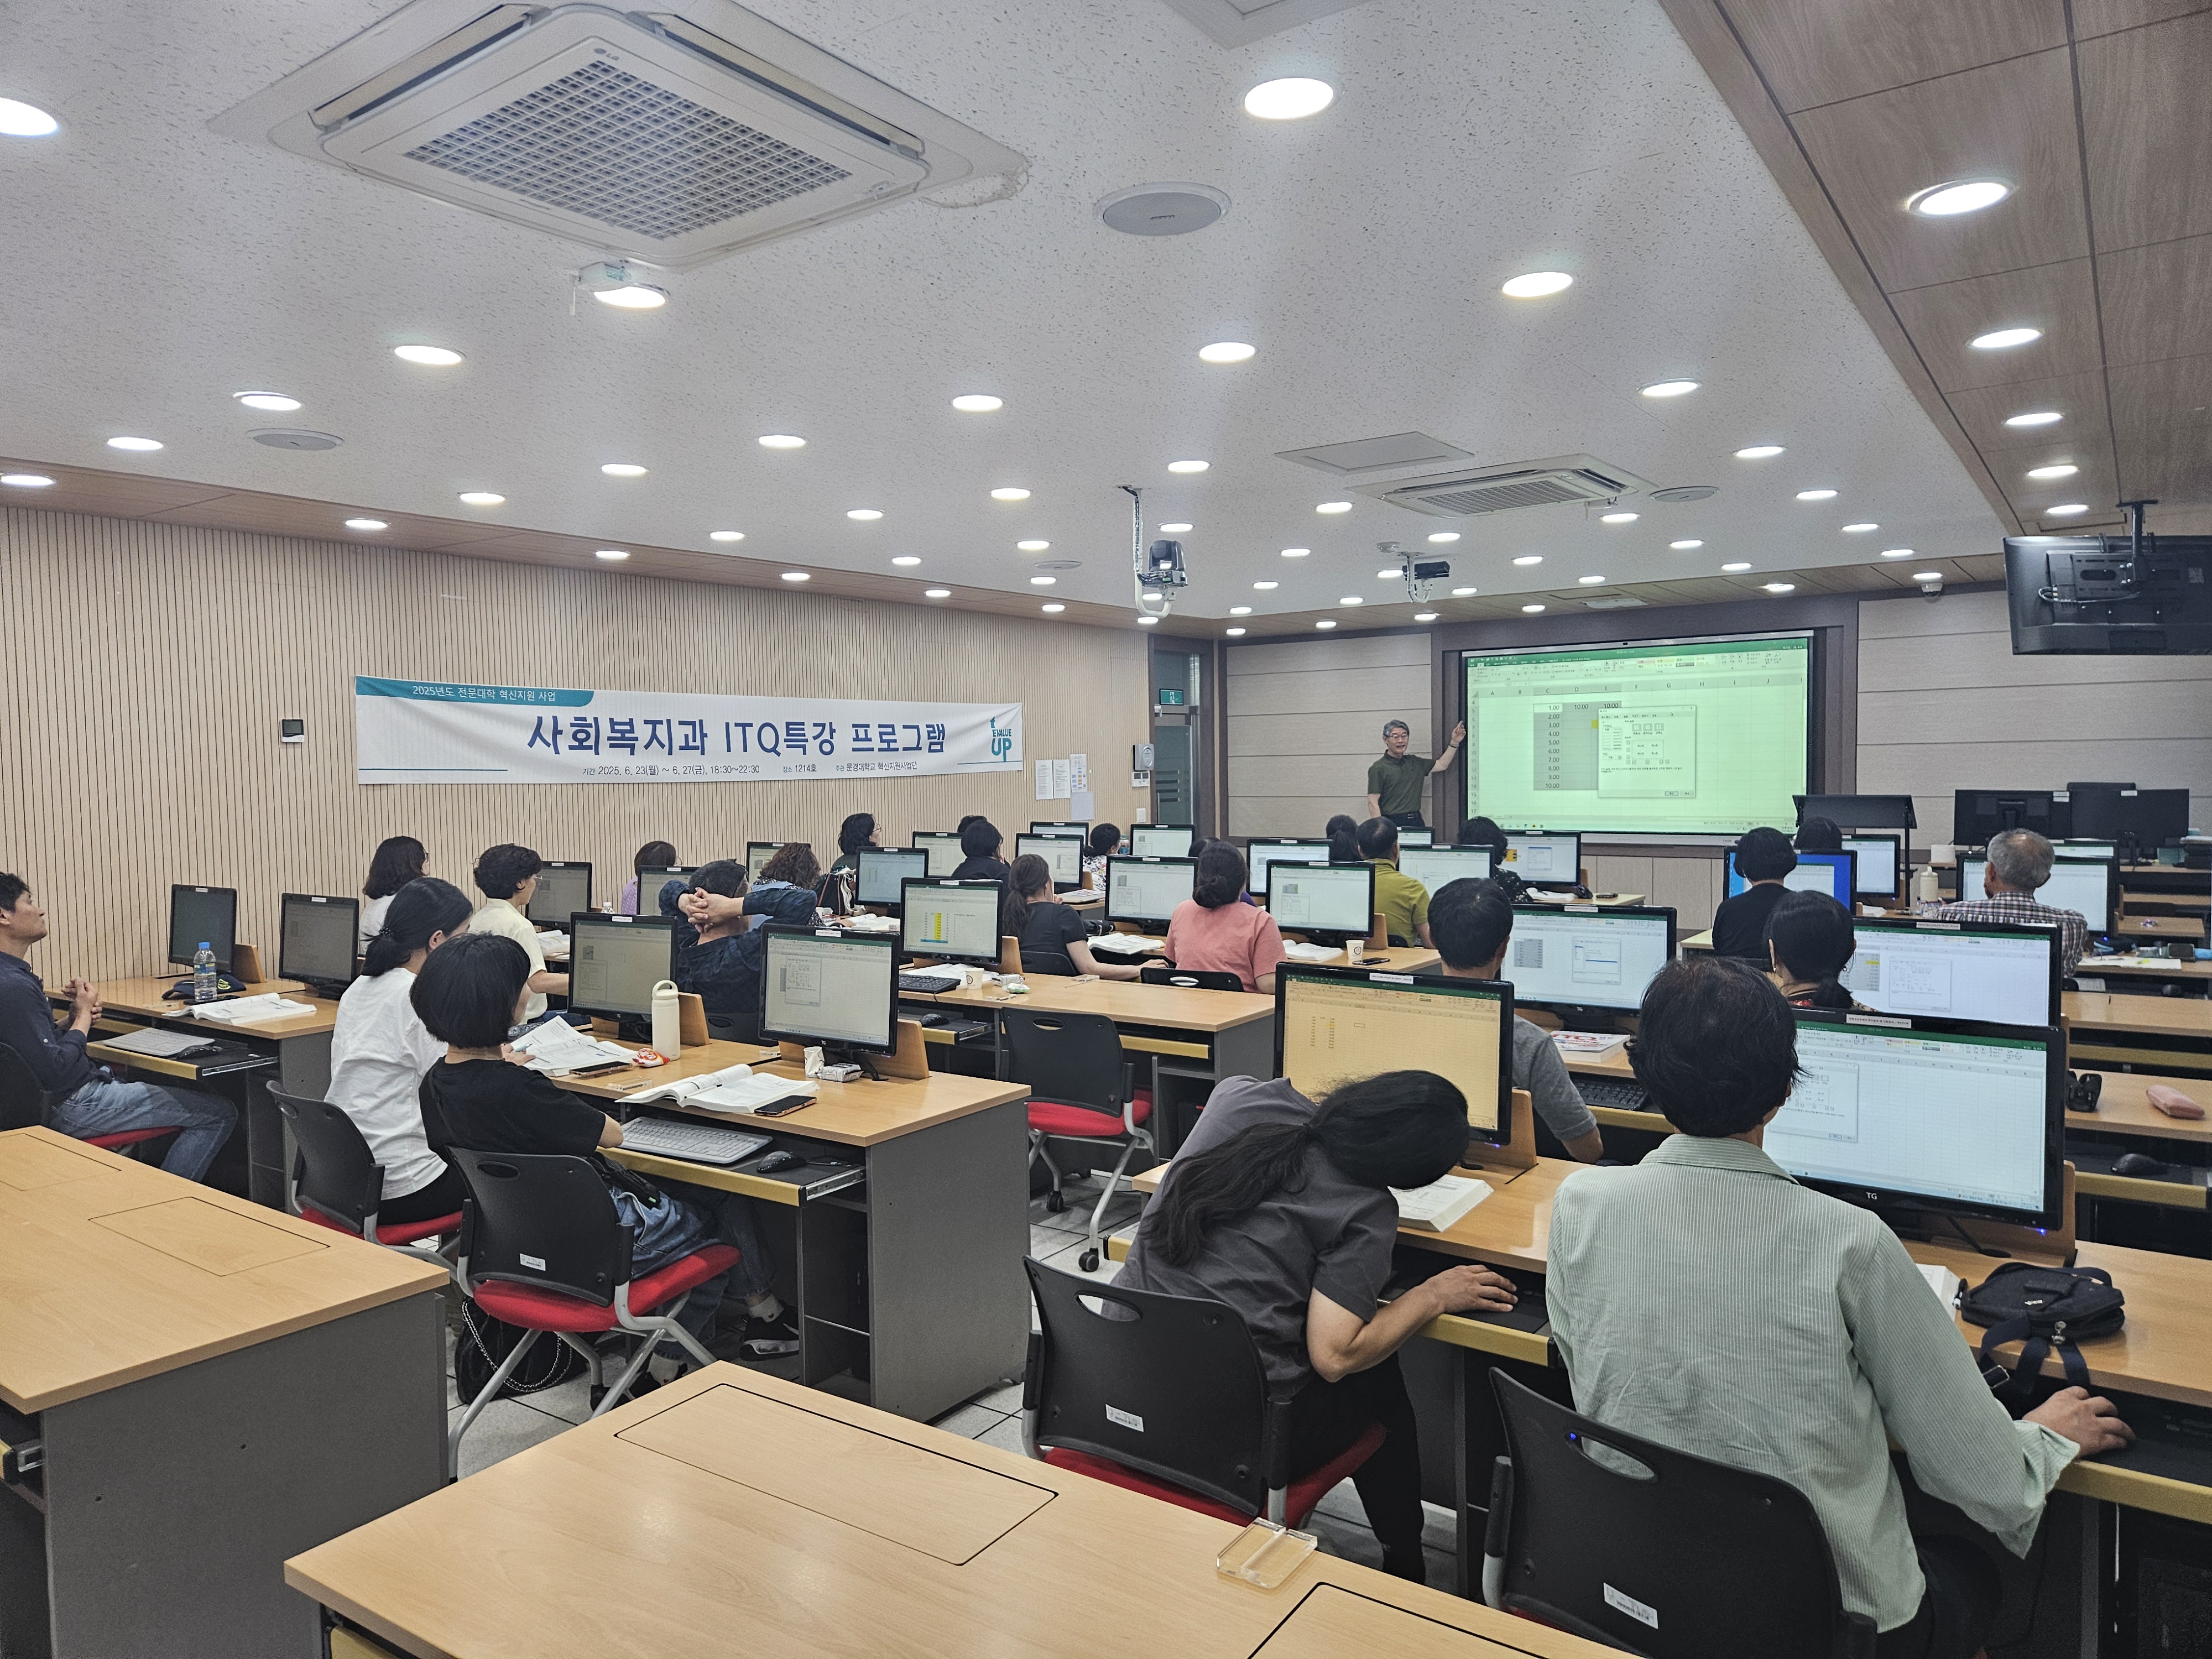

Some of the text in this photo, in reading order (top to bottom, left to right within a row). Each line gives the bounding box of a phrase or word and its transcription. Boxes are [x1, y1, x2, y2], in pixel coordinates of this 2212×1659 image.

[413, 686, 556, 702] 2025년도 전문대학 혁신지원 사업
[528, 715, 946, 758] 사회복지과 ITQ특강 프로그램
[992, 737, 1012, 762] UP
[598, 766, 622, 775] 2025.
[625, 766, 633, 775] 6.
[635, 765, 659, 776] 23(월)
[672, 766, 680, 775] 6.
[682, 764, 707, 775] 27(금),
[710, 765, 760, 774] 18:30~22:30
[795, 763, 817, 772] 1214호
[846, 762, 875, 771] 문경대학교
[878, 761, 917, 770] 혁신지원사업단
